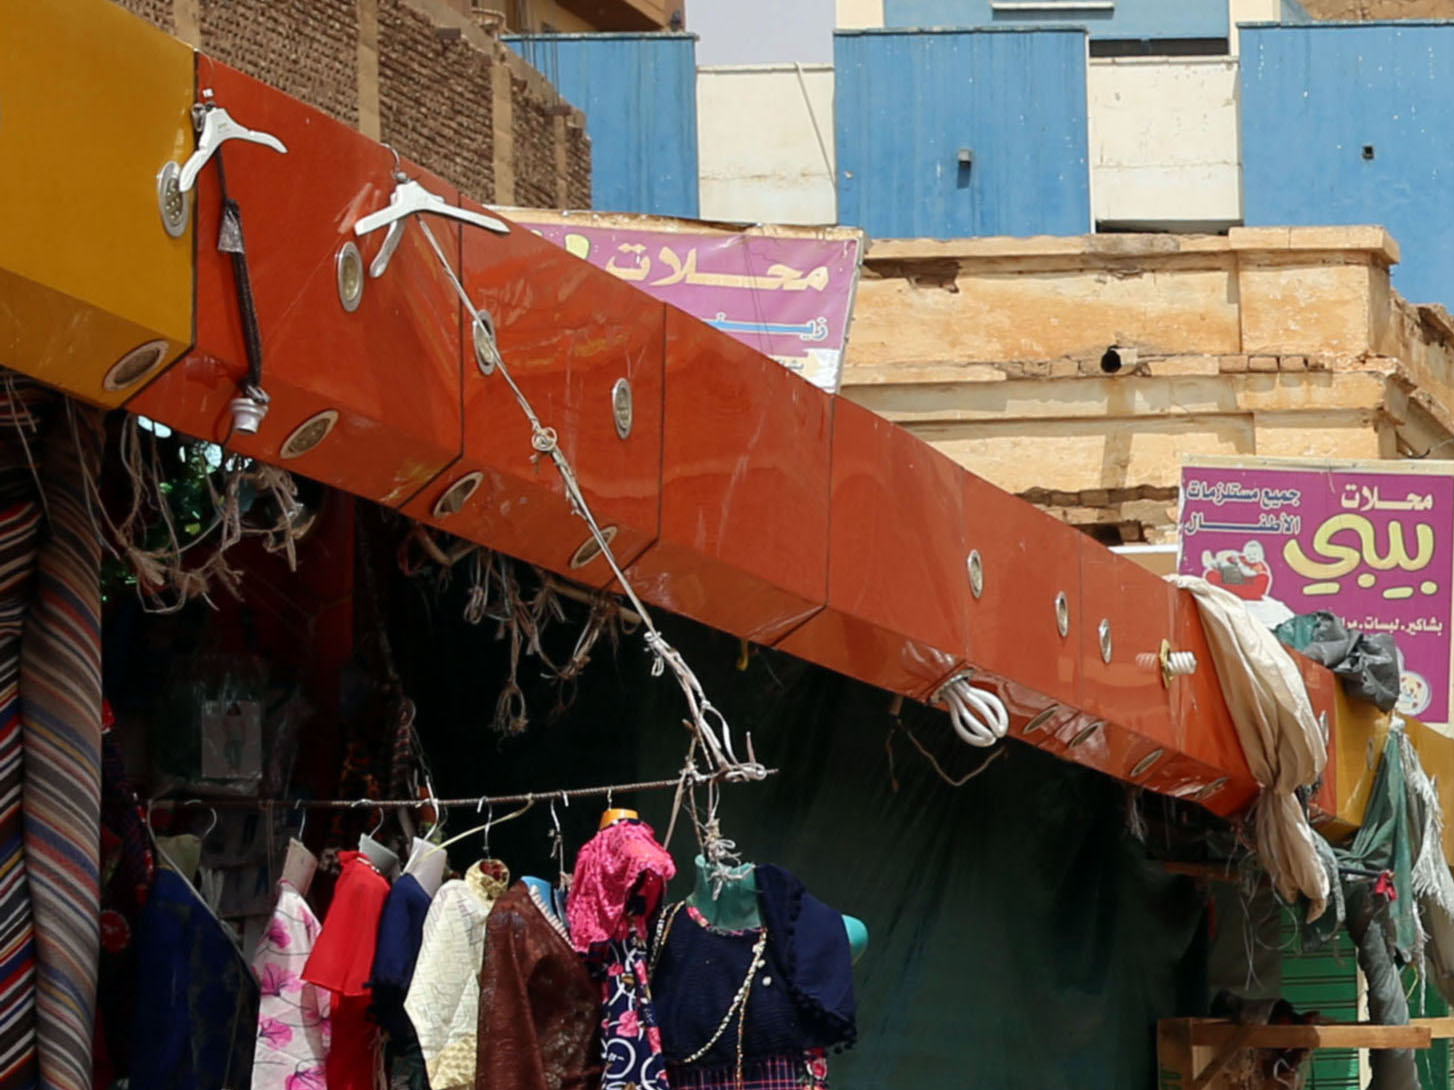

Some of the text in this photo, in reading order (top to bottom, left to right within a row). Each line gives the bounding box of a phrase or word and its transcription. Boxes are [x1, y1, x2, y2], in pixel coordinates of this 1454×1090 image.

[604, 243, 829, 291] محلات
[1187, 480, 1301, 510] جميع مستلزمات
[1341, 485, 1434, 511] محلات
[1282, 513, 1439, 600] بيبي
